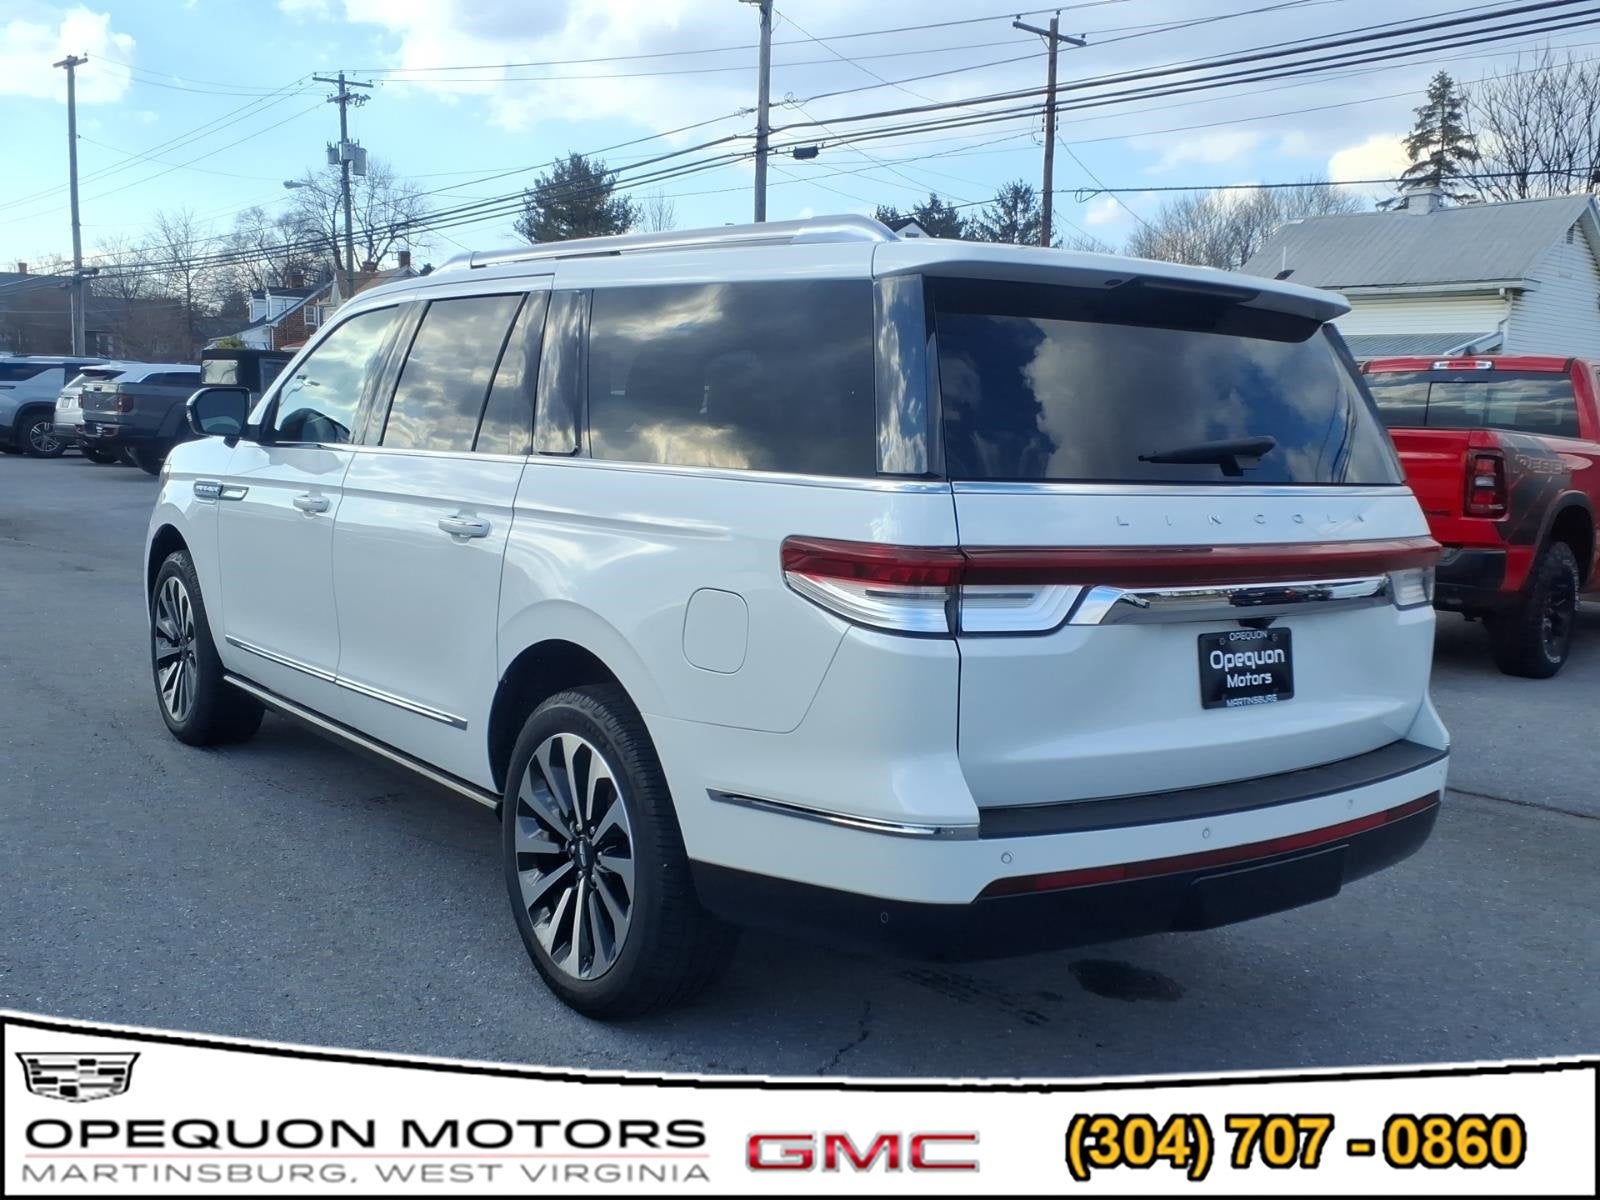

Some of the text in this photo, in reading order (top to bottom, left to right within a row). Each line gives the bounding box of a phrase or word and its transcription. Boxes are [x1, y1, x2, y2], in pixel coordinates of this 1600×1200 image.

[1115, 513, 1366, 527] LINCOLN
[1229, 630, 1268, 641] OPEQUON
[1210, 649, 1285, 672] Opequon
[1226, 672, 1272, 688] Motors
